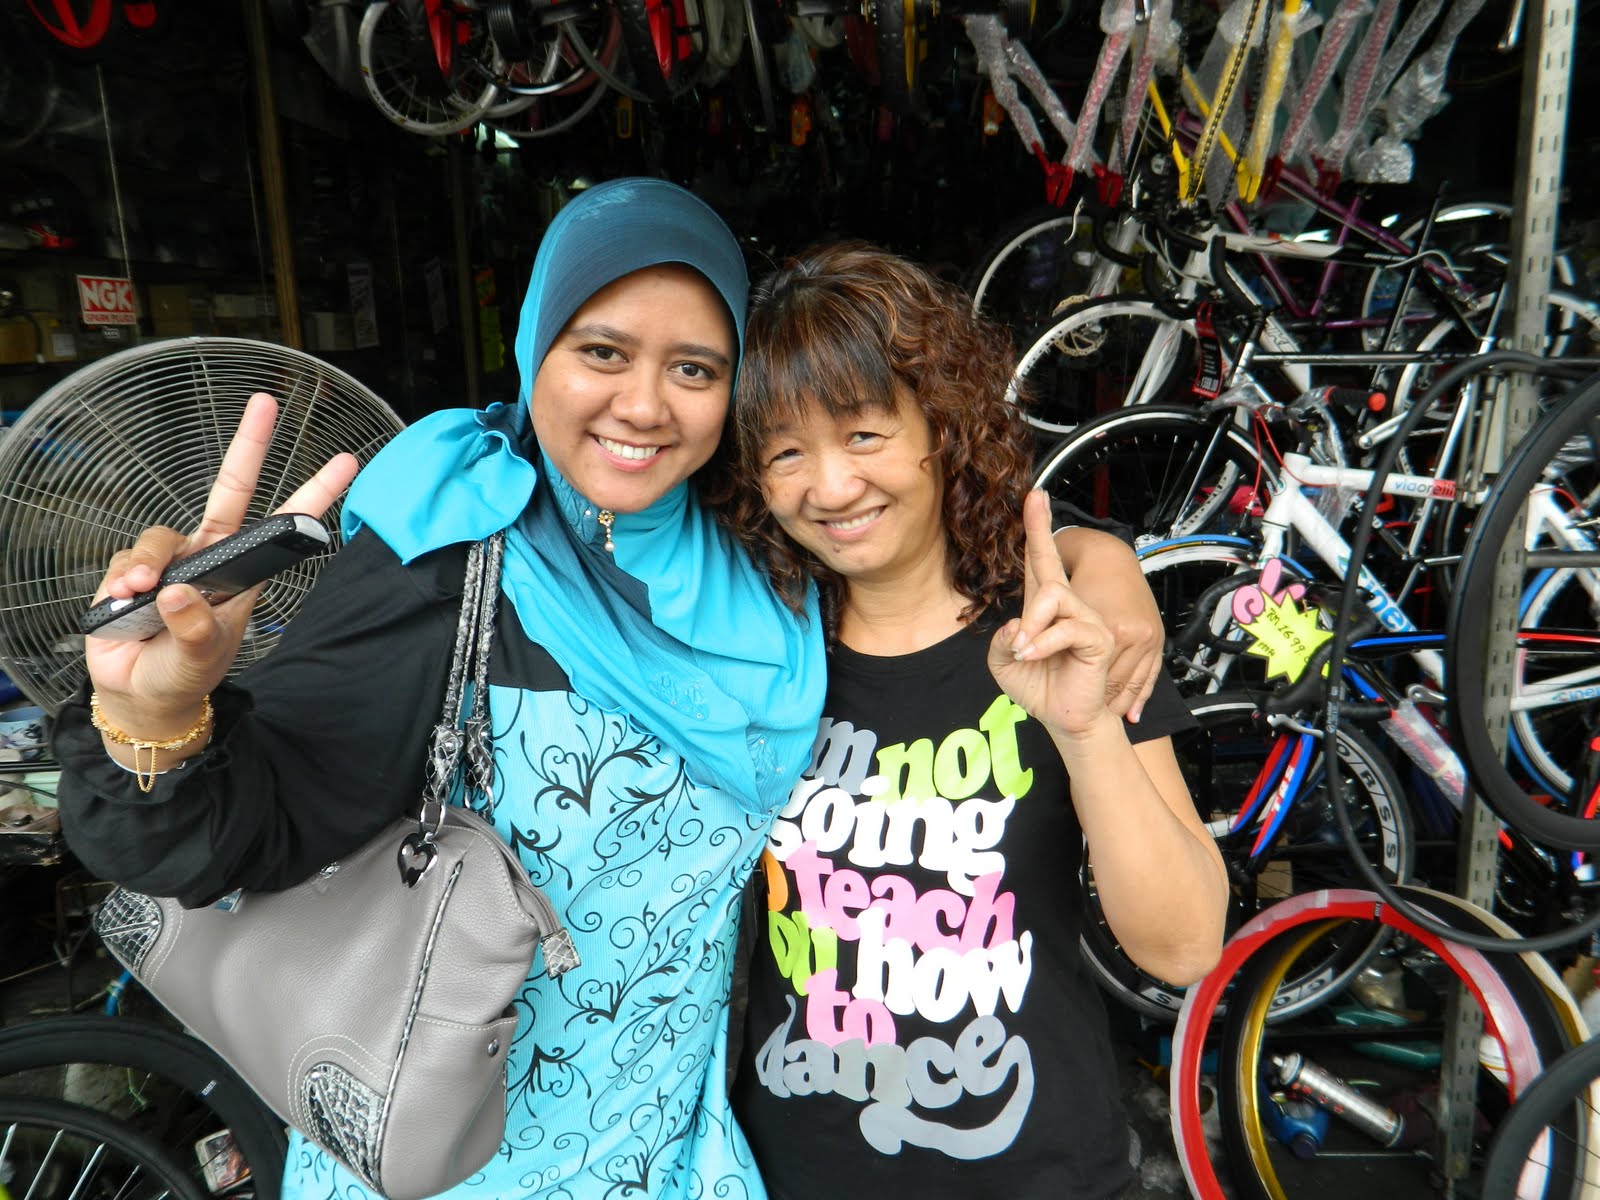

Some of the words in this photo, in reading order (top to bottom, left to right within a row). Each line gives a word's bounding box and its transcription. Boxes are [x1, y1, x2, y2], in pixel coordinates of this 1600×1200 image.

[80, 279, 134, 311] NGK
[803, 717, 878, 795] m
[871, 692, 1034, 806] not
[1336, 742, 1398, 859] ORSS
[766, 775, 1016, 897] going
[785, 839, 1016, 957] teach
[768, 910, 838, 997] ou
[851, 906, 1033, 1024] how
[804, 967, 897, 1050] to
[754, 994, 1035, 1161] dance
